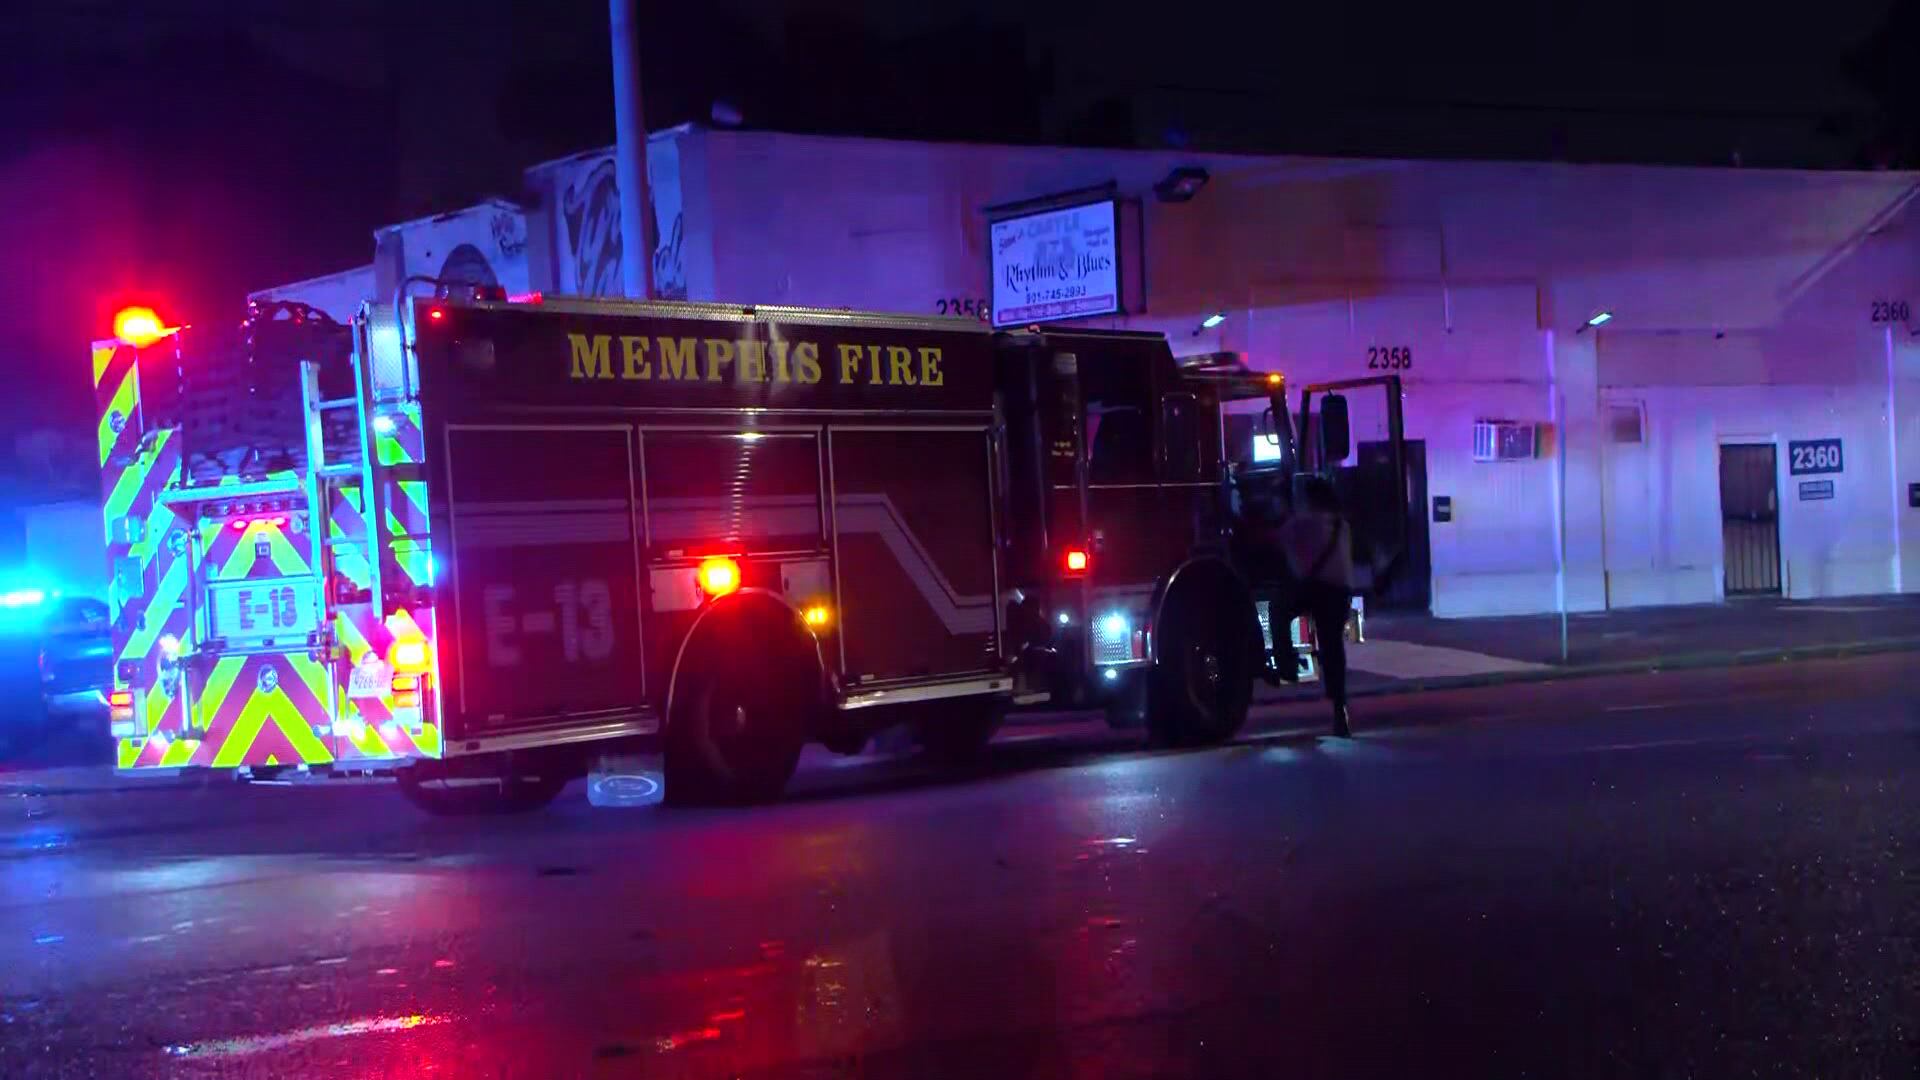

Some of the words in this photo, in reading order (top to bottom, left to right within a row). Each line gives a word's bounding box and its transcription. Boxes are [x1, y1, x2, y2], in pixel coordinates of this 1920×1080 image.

[1006, 257, 1055, 293] Rhythm
[1058, 259, 1069, 281] &
[1077, 252, 1111, 279] Blues
[1871, 301, 1910, 322] 2360
[567, 333, 822, 385] MEMPHIS
[837, 343, 944, 386] FIRE
[1368, 347, 1411, 369] 2358
[1792, 444, 1840, 469] 2360
[238, 586, 297, 629] E-13
[483, 580, 616, 668] E-13
